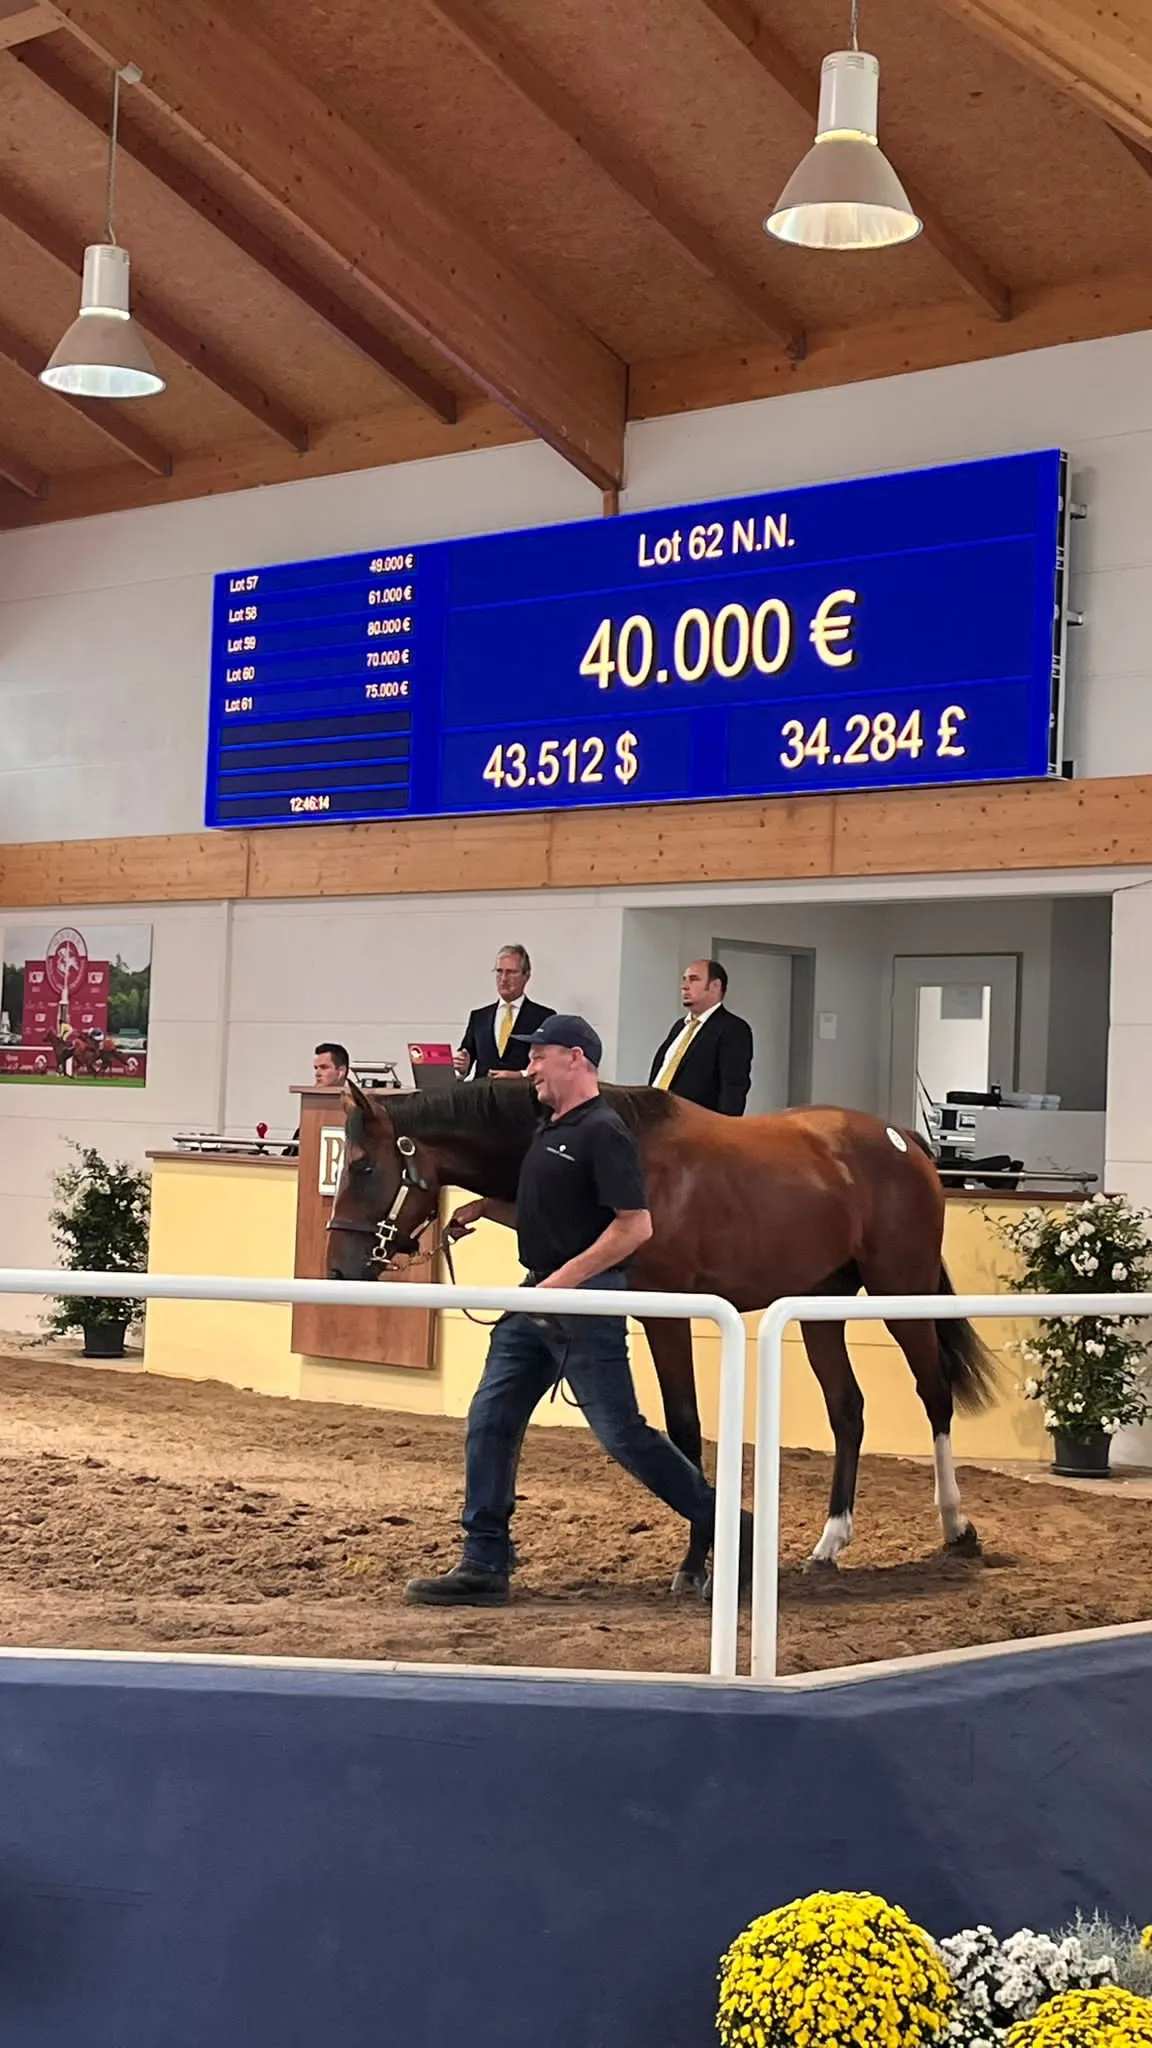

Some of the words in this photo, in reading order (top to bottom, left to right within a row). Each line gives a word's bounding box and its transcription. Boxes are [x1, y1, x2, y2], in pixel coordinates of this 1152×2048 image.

[638, 529, 682, 568] Lot
[688, 522, 724, 561] 62
[732, 513, 795, 555] N.N.
[368, 555, 404, 573] 49.000
[404, 553, 414, 569] €
[229, 578, 246, 593] Lot
[246, 575, 259, 591] 57
[368, 586, 403, 605] 61.000
[403, 585, 412, 601] €
[228, 608, 245, 623] Lot
[245, 605, 258, 621] 58
[367, 618, 402, 636] 80.000
[402, 616, 411, 632] €
[227, 638, 244, 653] Lot
[243, 635, 257, 651] 59
[579, 597, 791, 690] 40.000
[808, 588, 857, 667] €
[366, 649, 401, 667] 70.000
[401, 648, 410, 664] €
[226, 668, 242, 683] Lot
[242, 666, 256, 681] 60
[365, 680, 399, 699] 75.000
[400, 680, 409, 696] €
[224, 698, 241, 713] Lot
[240, 696, 253, 711] 61
[779, 709, 924, 769] 34.284
[936, 705, 967, 758] £
[482, 736, 604, 790] 43.512
[614, 730, 638, 785] $
